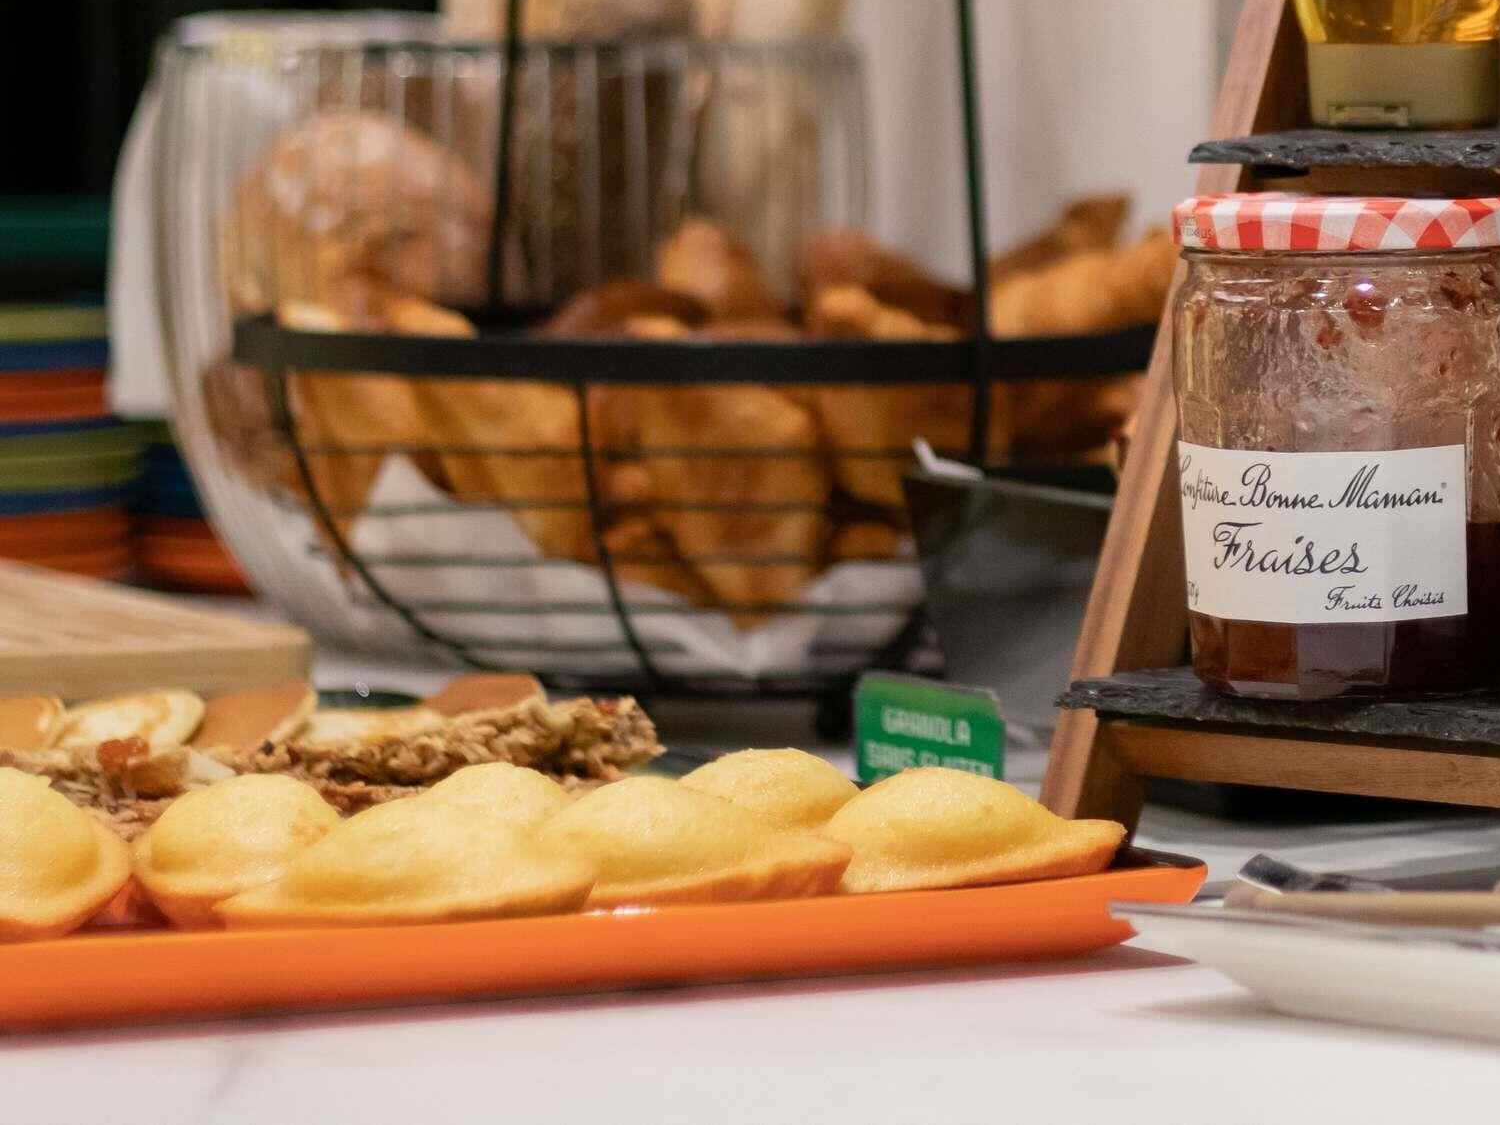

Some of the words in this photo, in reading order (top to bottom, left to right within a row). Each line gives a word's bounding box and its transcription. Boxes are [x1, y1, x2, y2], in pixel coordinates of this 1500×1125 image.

[1239, 463, 1323, 509] Bonne
[1328, 463, 1444, 509] Maman
[1213, 521, 1368, 576] Fraises
[1324, 584, 1383, 611] Fruits
[1391, 584, 1445, 608] Choisis
